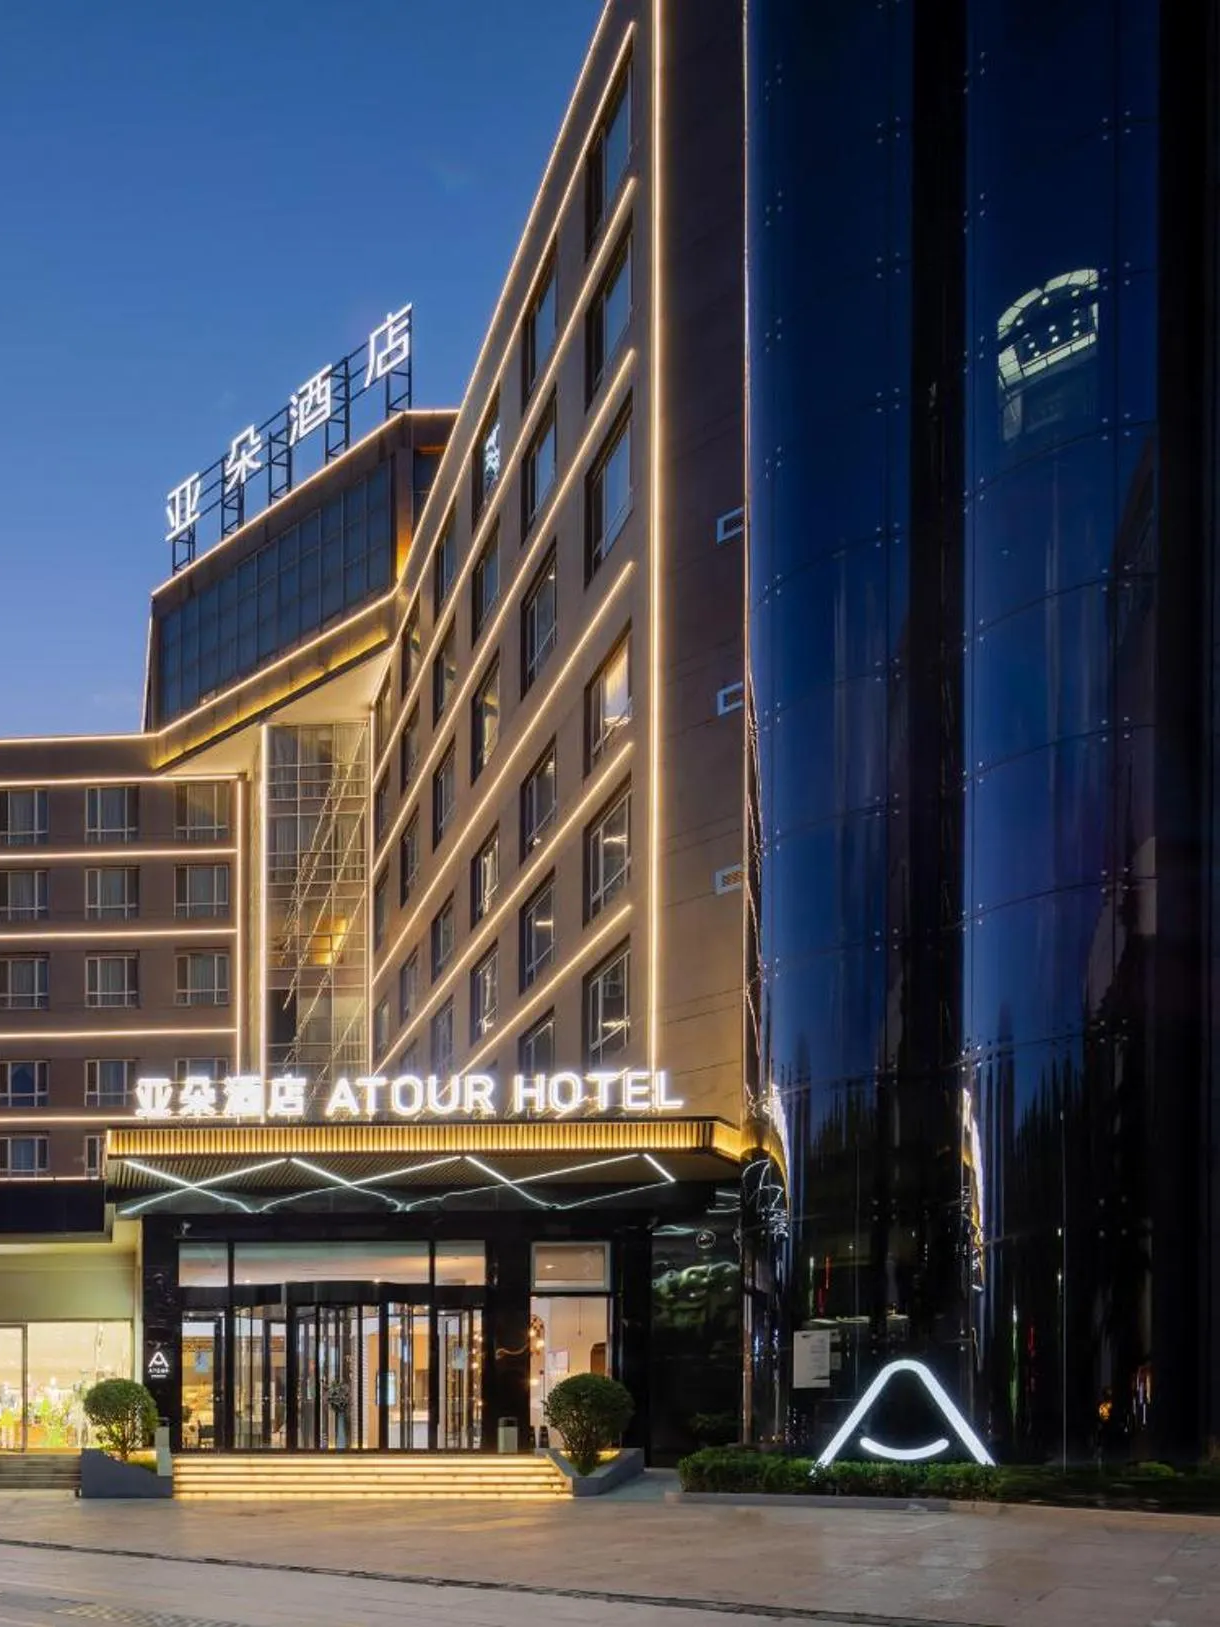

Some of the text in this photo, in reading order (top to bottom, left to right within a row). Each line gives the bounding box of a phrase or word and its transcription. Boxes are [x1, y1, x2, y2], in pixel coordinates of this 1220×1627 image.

[166, 303, 412, 542] 亚朵酒店
[135, 1074, 307, 1118] 亚朵酒店
[325, 1071, 684, 1116] ATOUR HOTEL
